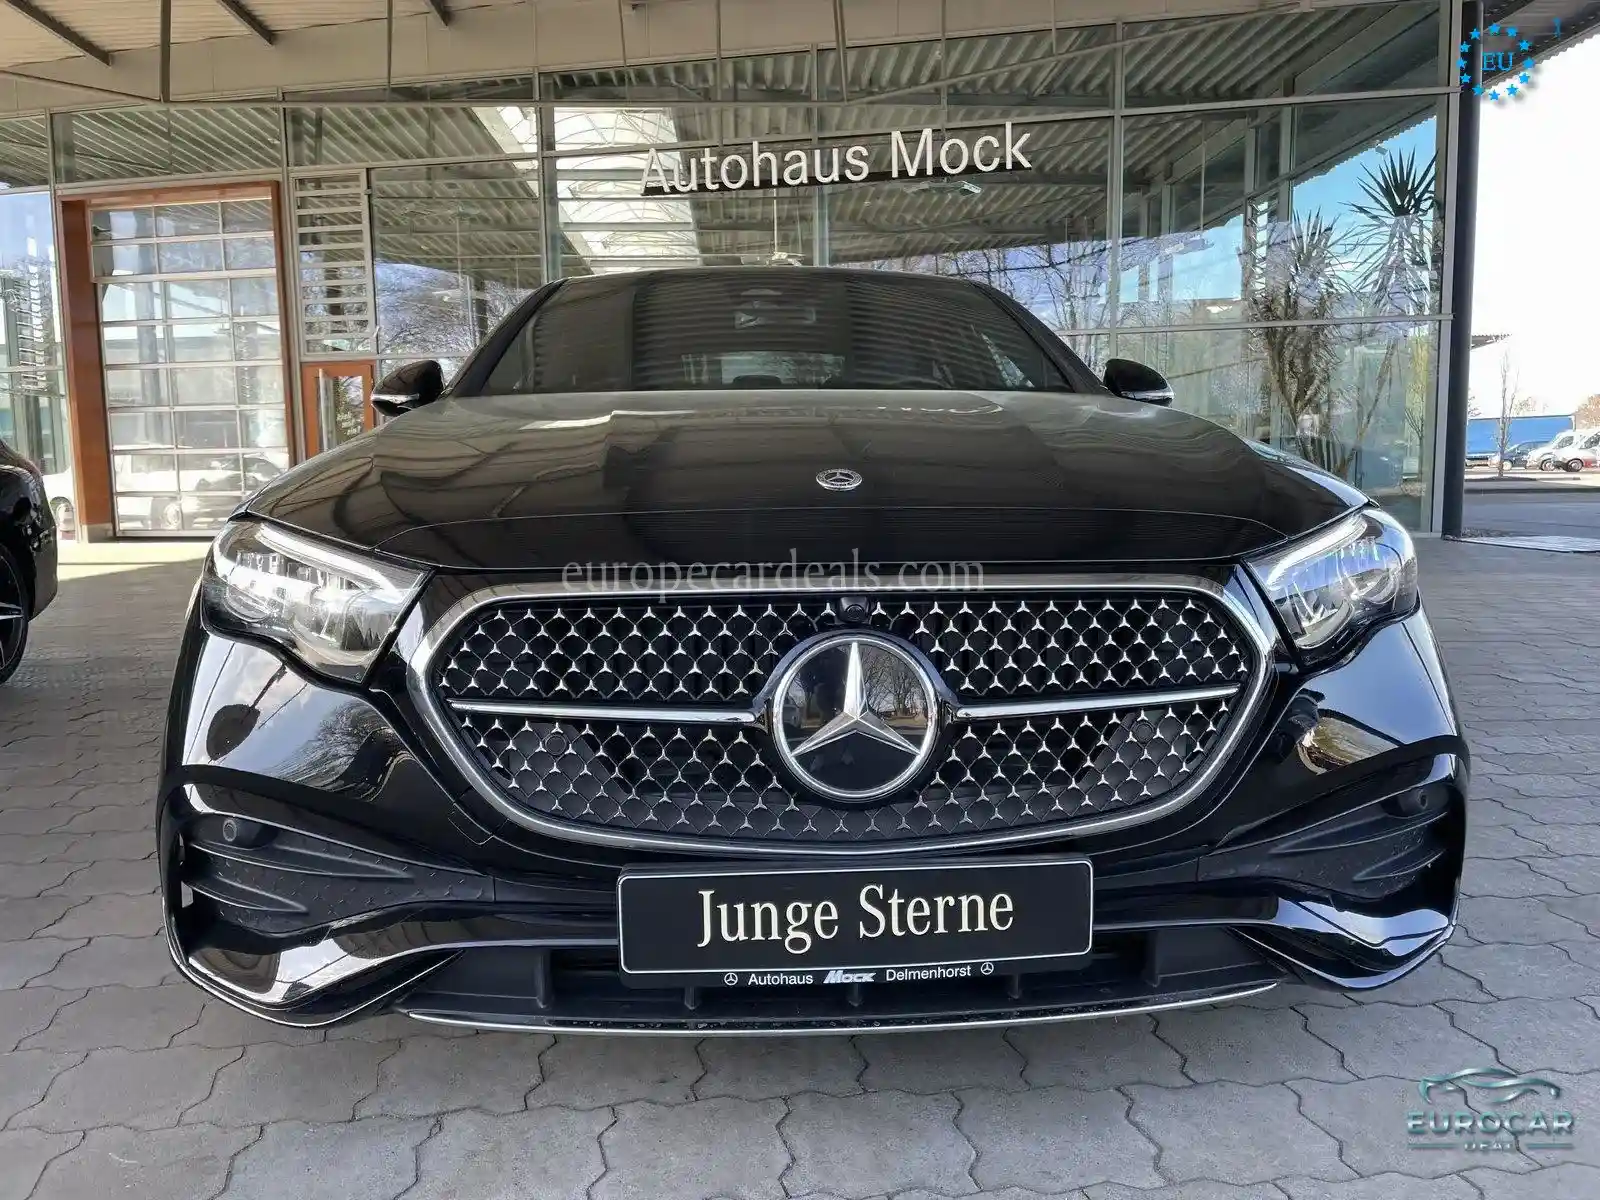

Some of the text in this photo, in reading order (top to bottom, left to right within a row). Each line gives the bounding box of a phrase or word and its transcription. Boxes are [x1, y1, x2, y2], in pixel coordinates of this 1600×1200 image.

[640, 122, 1032, 195] Autohaus Mock
[697, 884, 1014, 954] Junge Sterne
[748, 973, 813, 985] Autohaus
[886, 965, 971, 981] Delmenhorst
